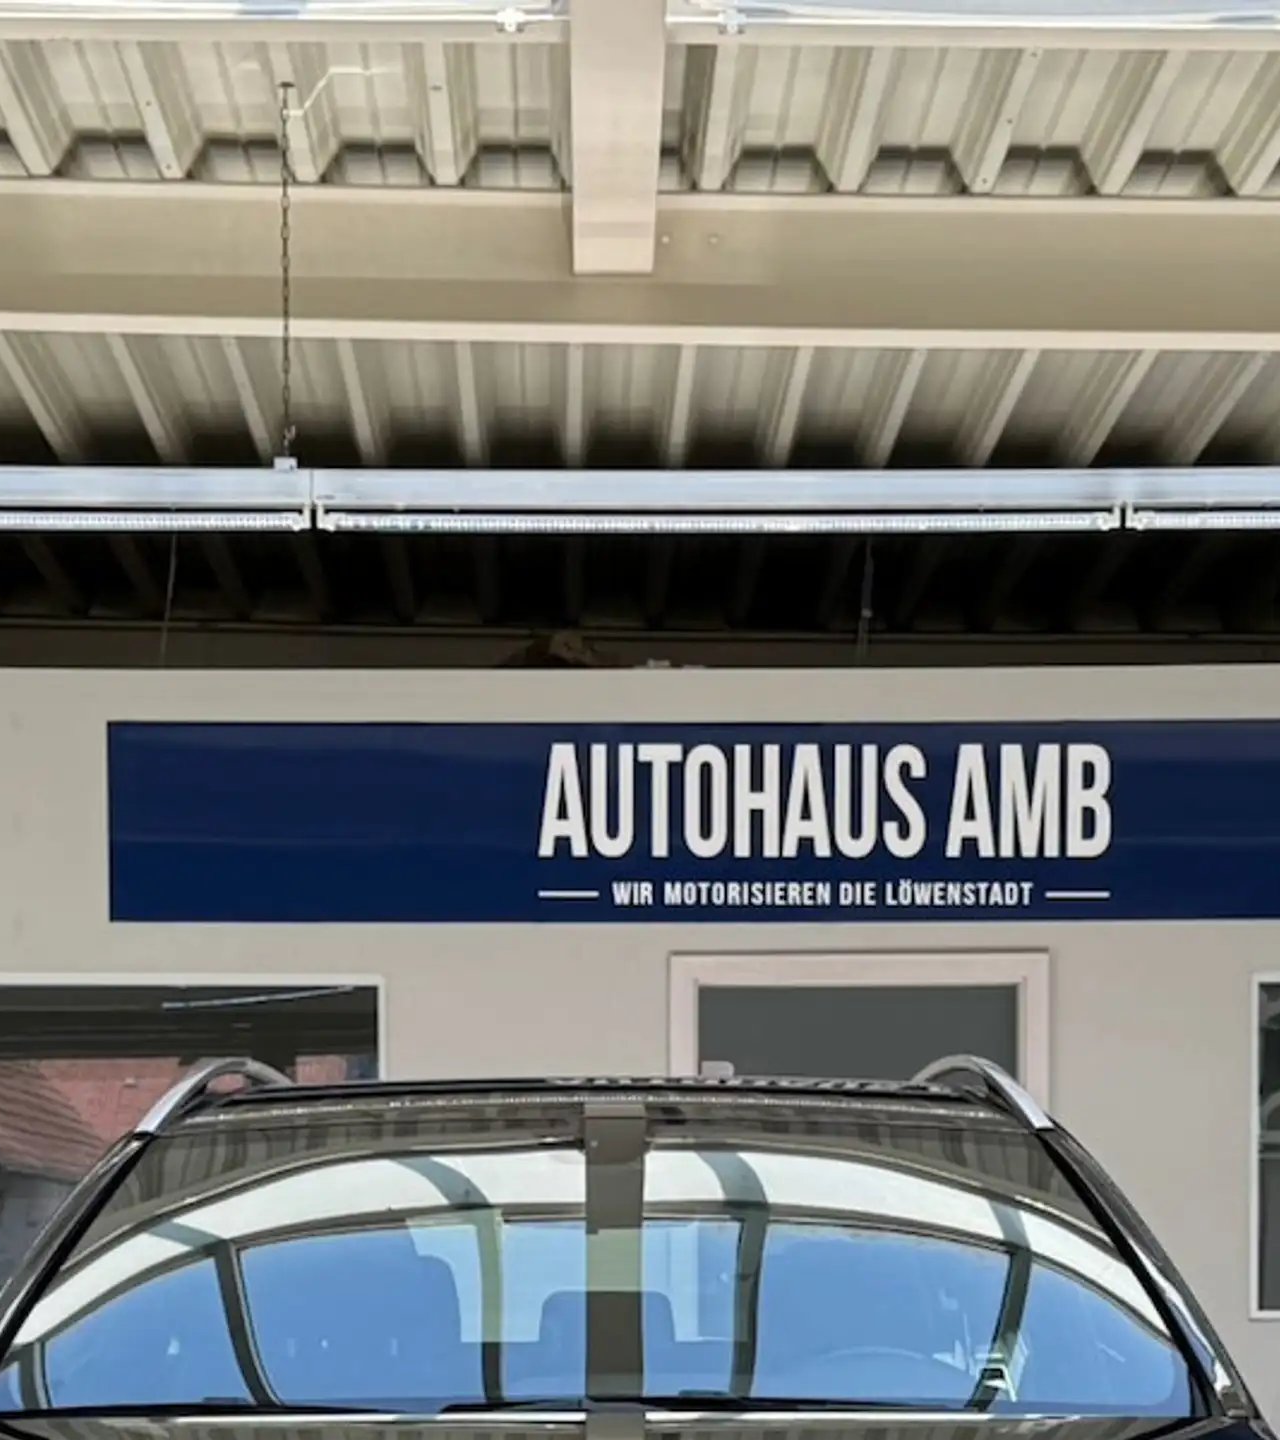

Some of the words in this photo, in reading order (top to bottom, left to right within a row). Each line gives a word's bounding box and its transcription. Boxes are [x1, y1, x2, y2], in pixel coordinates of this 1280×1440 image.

[537, 742, 927, 859] AUTOHAUS
[945, 742, 1112, 859] AMB
[611, 880, 654, 907] WIR
[663, 880, 832, 907] MOTORISIEREN
[838, 880, 878, 907] DIE
[884, 877, 1035, 907] LÖWENSTADT
